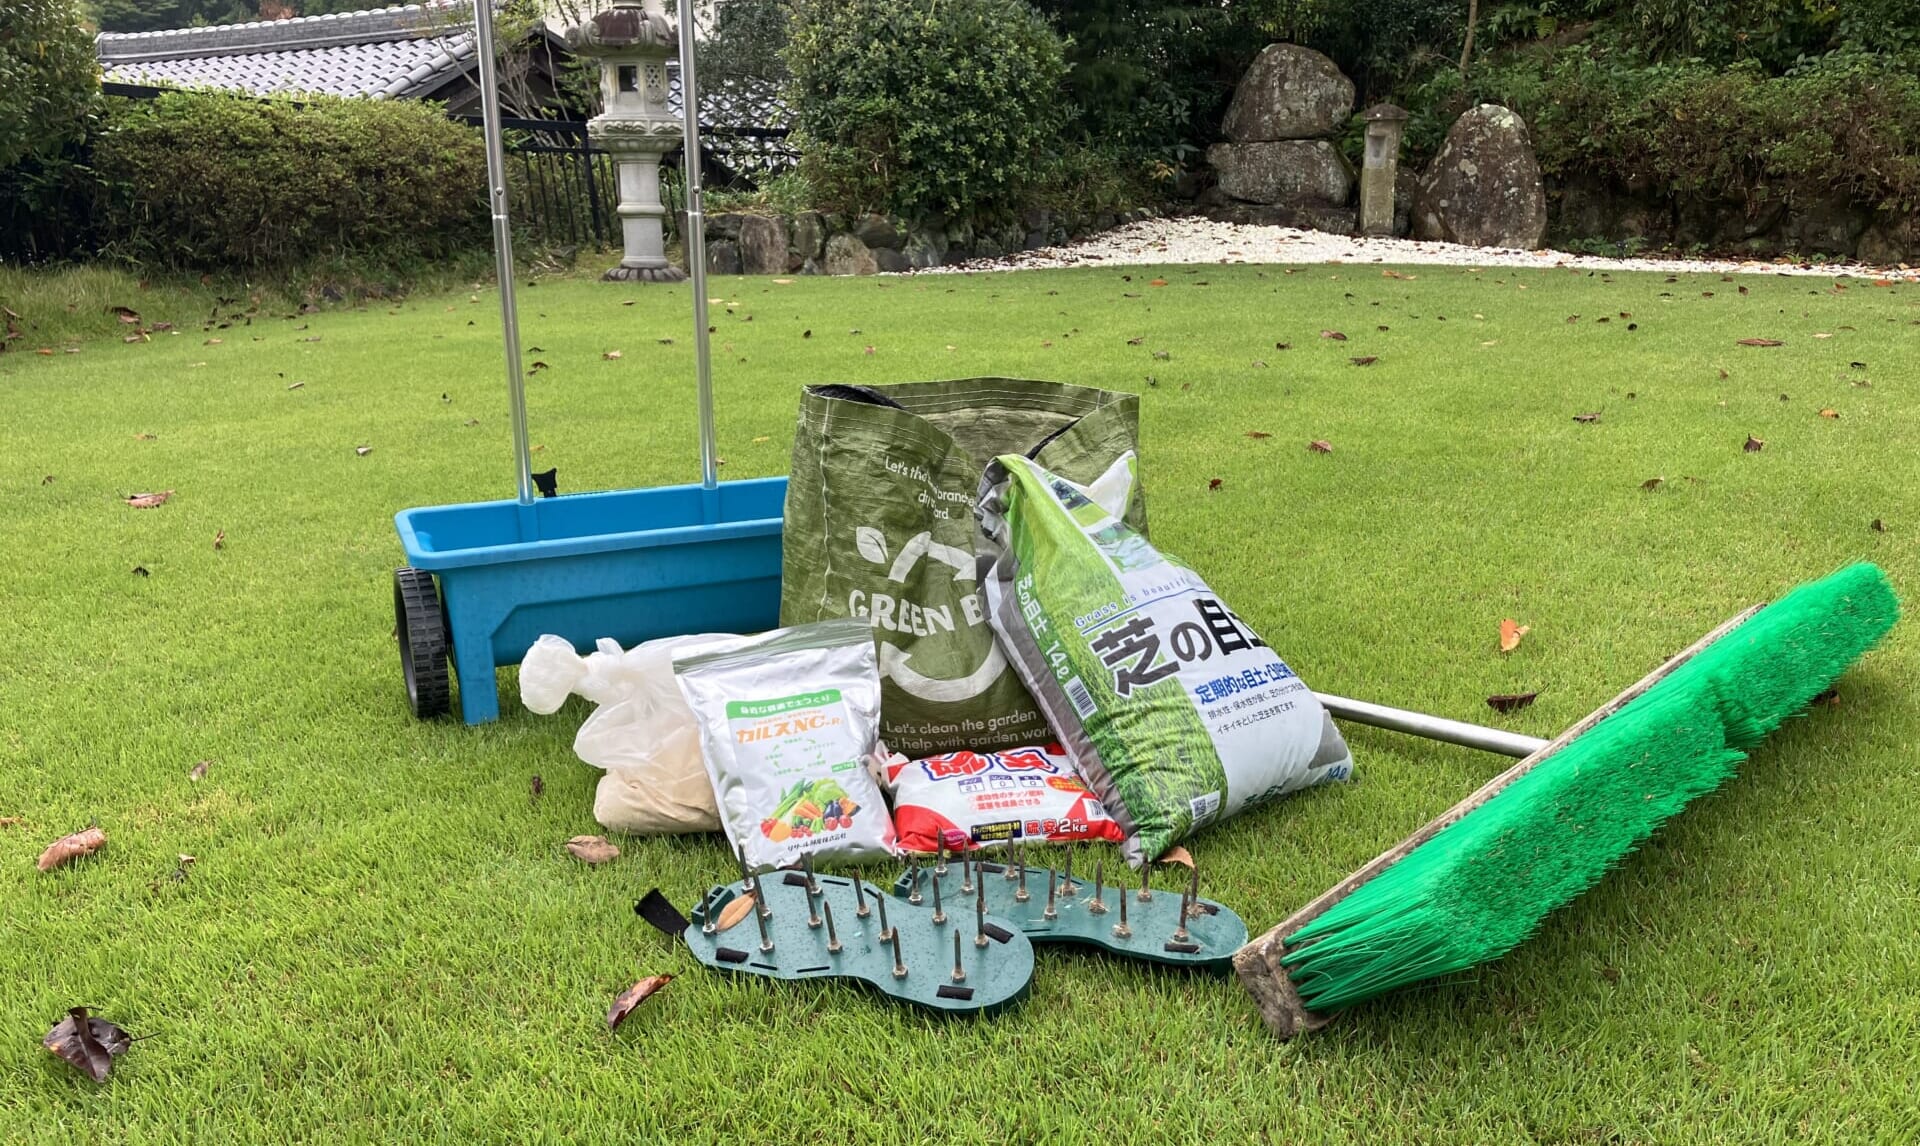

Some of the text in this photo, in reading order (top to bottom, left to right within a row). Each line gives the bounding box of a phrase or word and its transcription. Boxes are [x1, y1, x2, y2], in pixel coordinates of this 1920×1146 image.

[886, 456, 908, 475] Let's
[849, 589, 955, 636] GREEN
[1075, 603, 1117, 627] Grass
[1123, 594, 1137, 604] is
[886, 709, 1037, 735] Let's clean the garden
[902, 737, 933, 751] help
[936, 735, 965, 747] with
[969, 729, 1018, 747] garden
[1025, 819, 1057, 836] 硫安
[1059, 817, 1088, 833] 2kg
